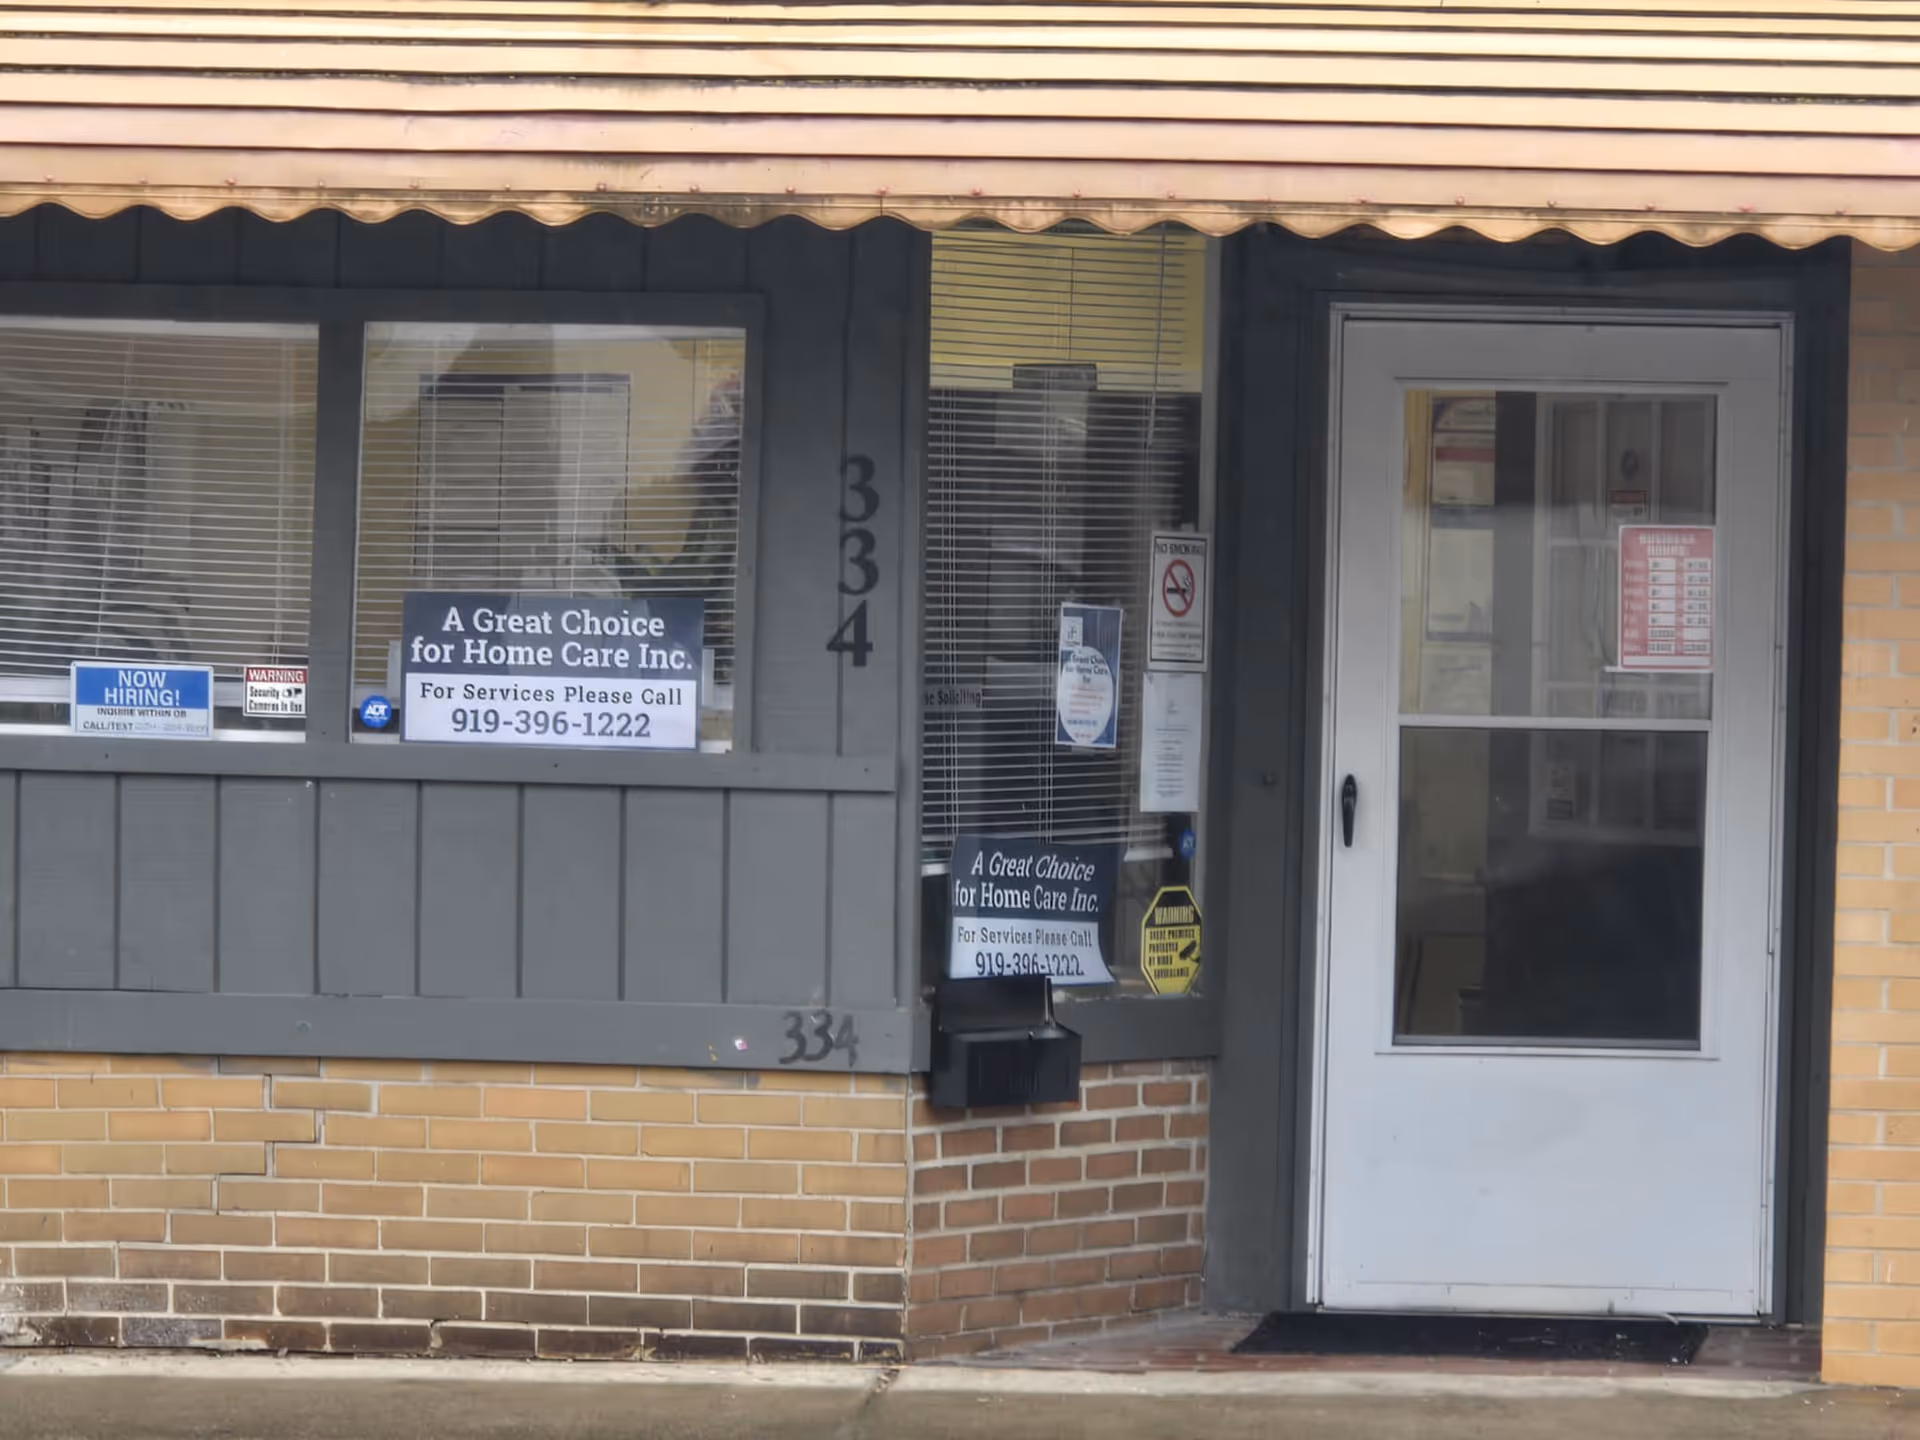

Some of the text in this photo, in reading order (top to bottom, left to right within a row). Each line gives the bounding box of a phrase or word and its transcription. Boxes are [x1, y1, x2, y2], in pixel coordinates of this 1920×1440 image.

[826, 455, 879, 667] 334
[442, 606, 665, 637] A Great Choice
[410, 635, 693, 670] for Home Care Inc.
[118, 670, 166, 688] NOW
[248, 668, 304, 682] WARNING
[104, 688, 180, 706] HIRING!
[249, 686, 280, 699] Security
[420, 682, 682, 705] For Services Please Call
[364, 703, 388, 718] ADT
[451, 708, 651, 738] 919-396-1222
[971, 851, 1095, 881] A Great Choice
[955, 879, 1099, 913] for Home Care Inc.
[958, 926, 976, 943] For
[981, 926, 1032, 945] Services
[975, 952, 1085, 977] 919-396-1222
[779, 1008, 860, 1068] 334
